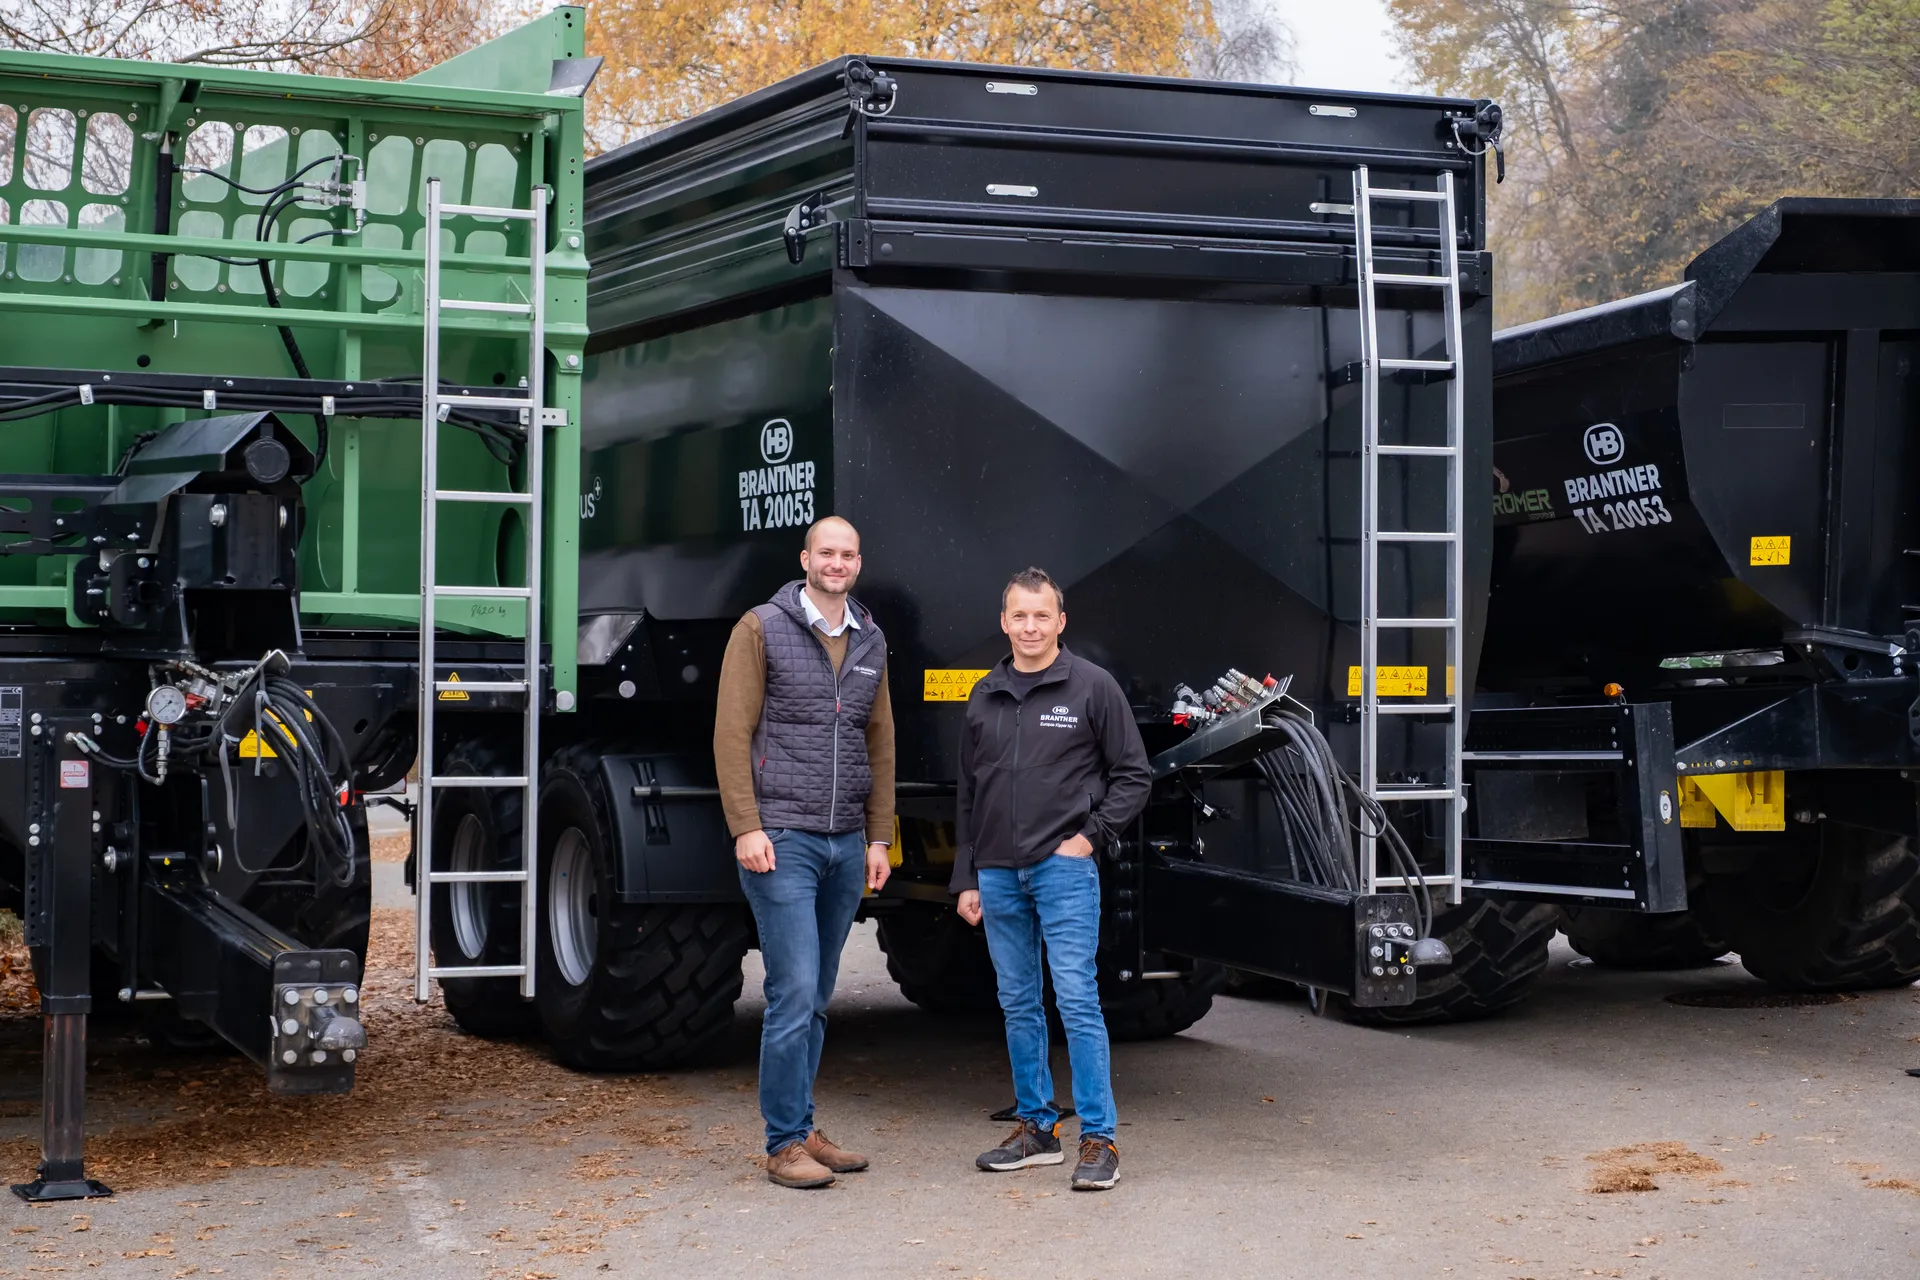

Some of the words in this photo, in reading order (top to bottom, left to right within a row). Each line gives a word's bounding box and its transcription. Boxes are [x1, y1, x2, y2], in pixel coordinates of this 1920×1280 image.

[739, 461, 815, 498] BRANTNER
[1564, 464, 1662, 504] BRANTNER
[740, 498, 762, 531] TA
[764, 490, 815, 528] 20053
[1573, 508, 1610, 535] TA
[1603, 495, 1673, 530] 20053
[1040, 714, 1078, 723] BRANTNER
